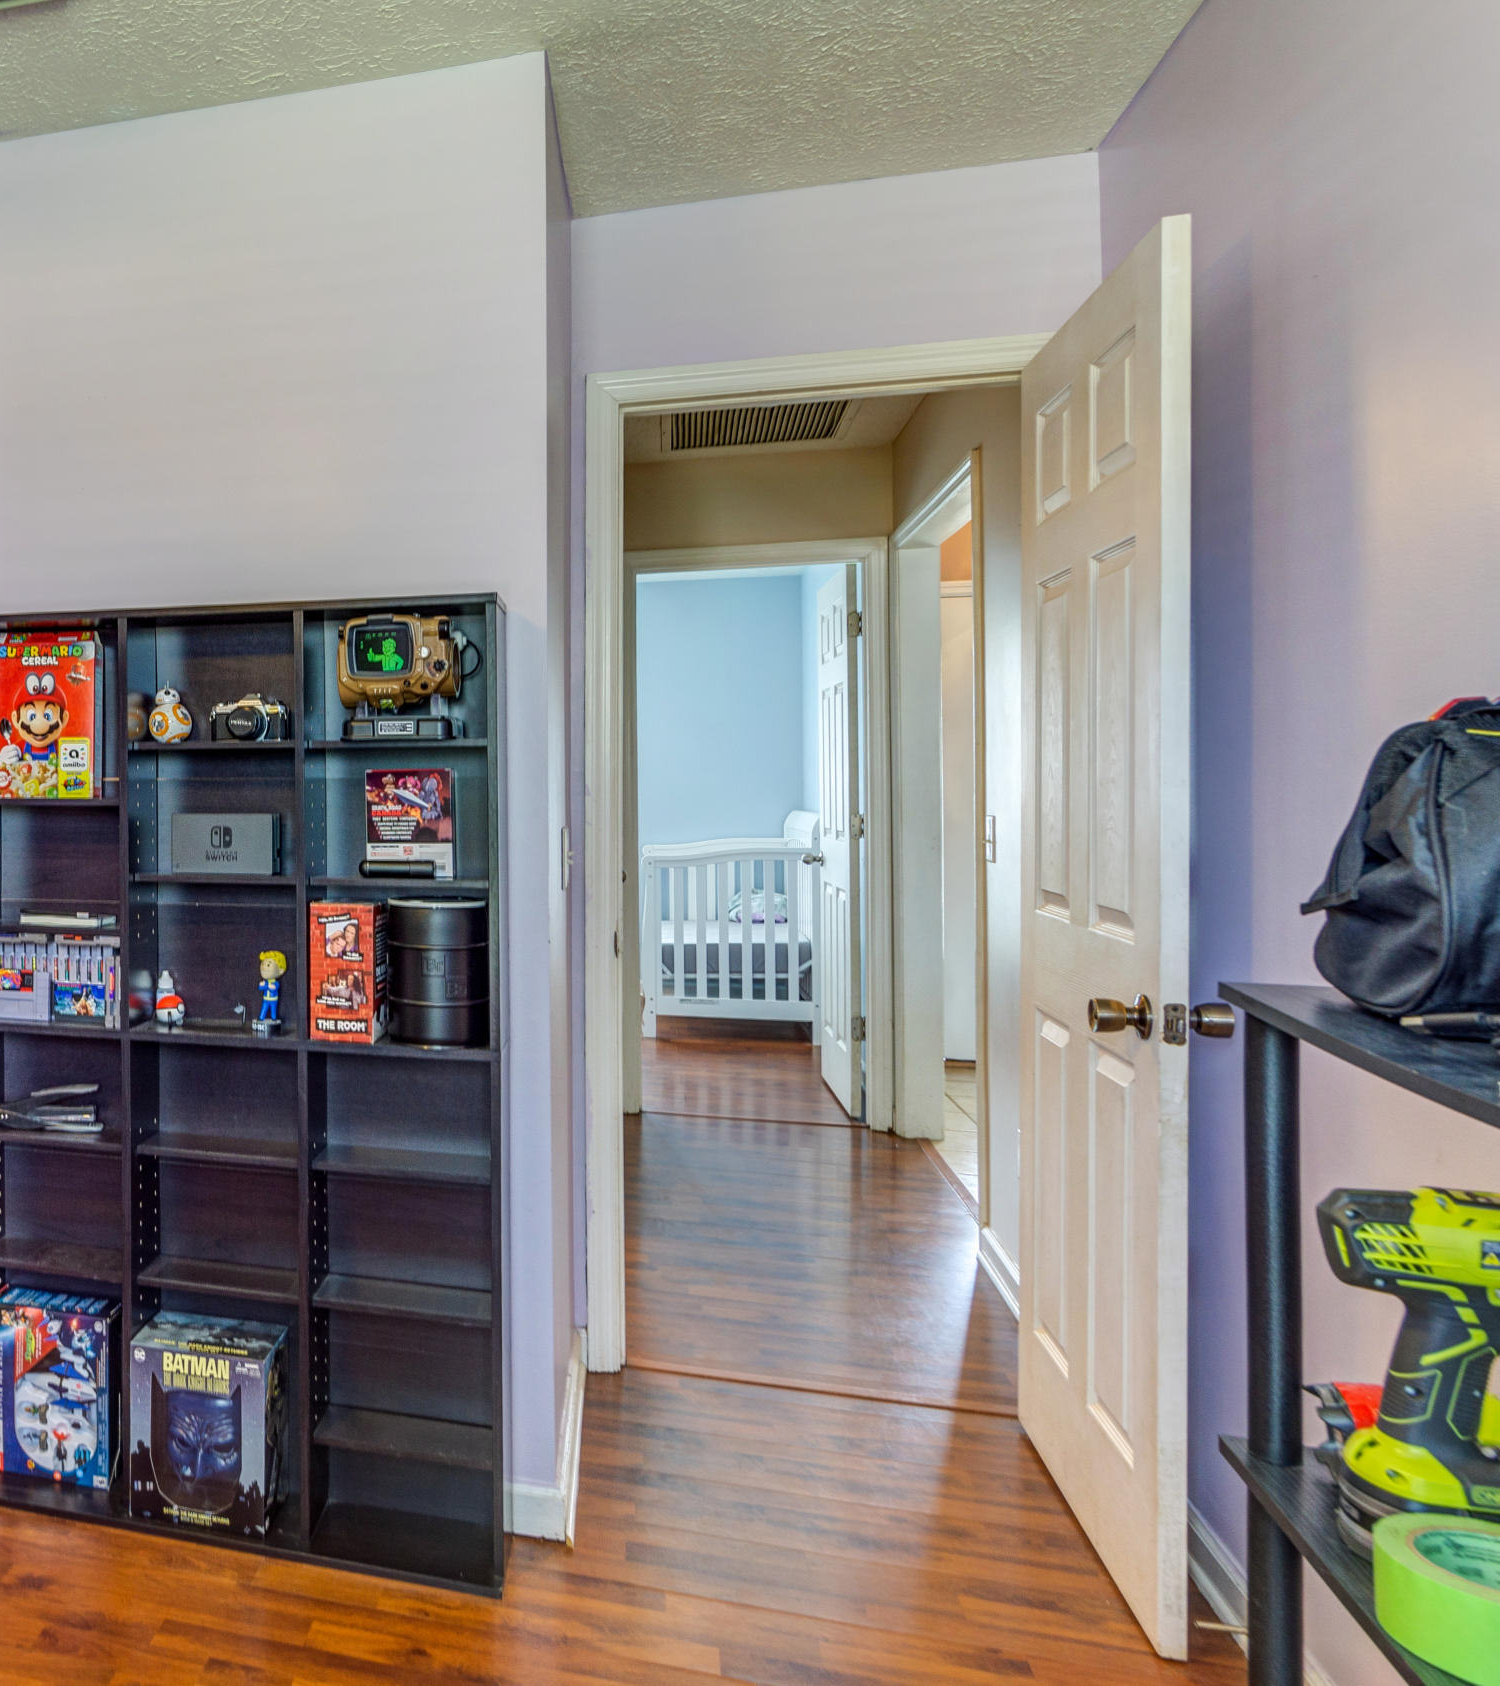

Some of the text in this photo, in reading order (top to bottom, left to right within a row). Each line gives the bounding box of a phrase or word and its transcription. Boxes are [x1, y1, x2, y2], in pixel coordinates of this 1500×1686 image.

[41, 645, 83, 658] MARIO
[21, 656, 59, 666] CEREAL
[205, 854, 238, 862] SWITCH
[316, 1019, 366, 1032] THE ROOM
[134, 1349, 146, 1359] DC
[162, 1351, 230, 1380] BATMAN
